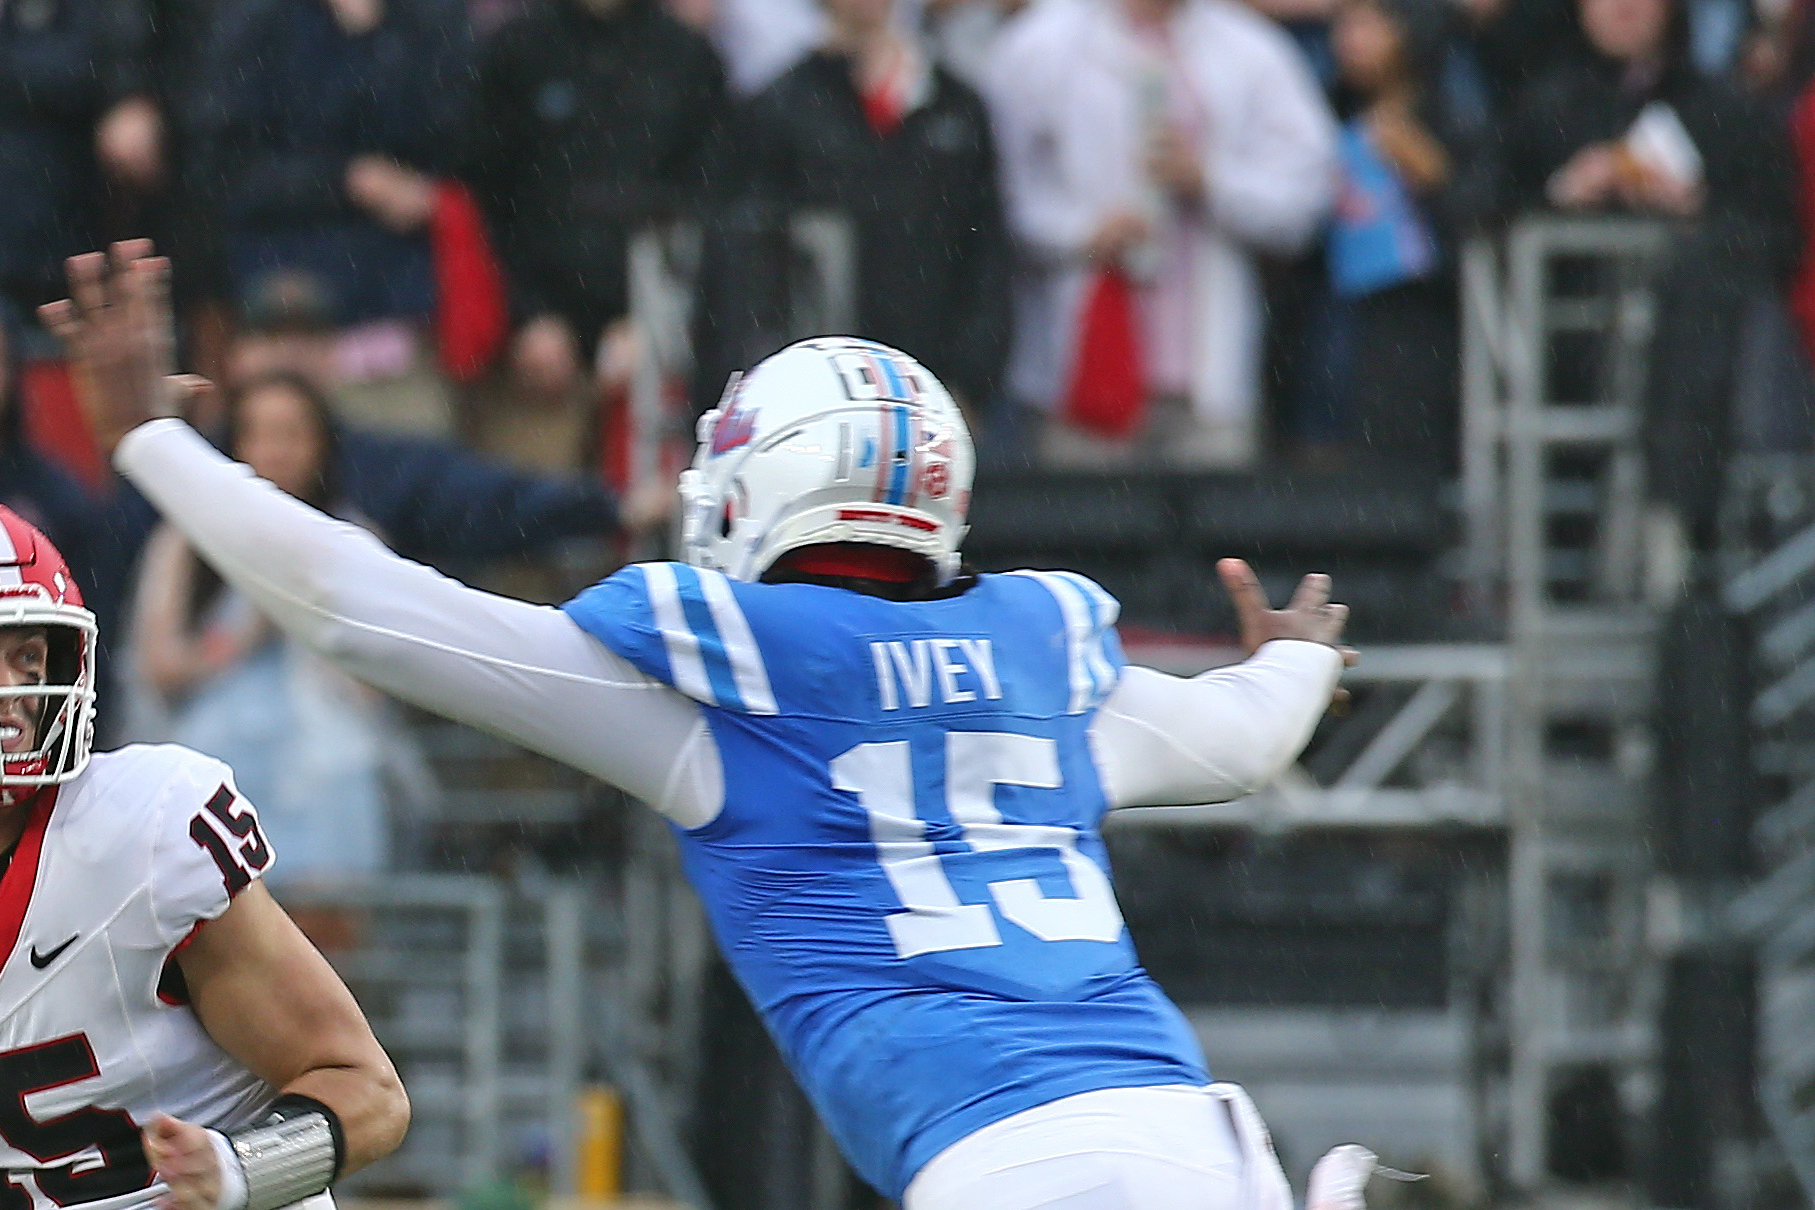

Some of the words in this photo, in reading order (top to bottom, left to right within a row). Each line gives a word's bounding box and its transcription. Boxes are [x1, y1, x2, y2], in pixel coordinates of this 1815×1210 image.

[869, 638, 1003, 712] IVEY
[189, 784, 270, 899] 15
[829, 730, 1125, 960] 15
